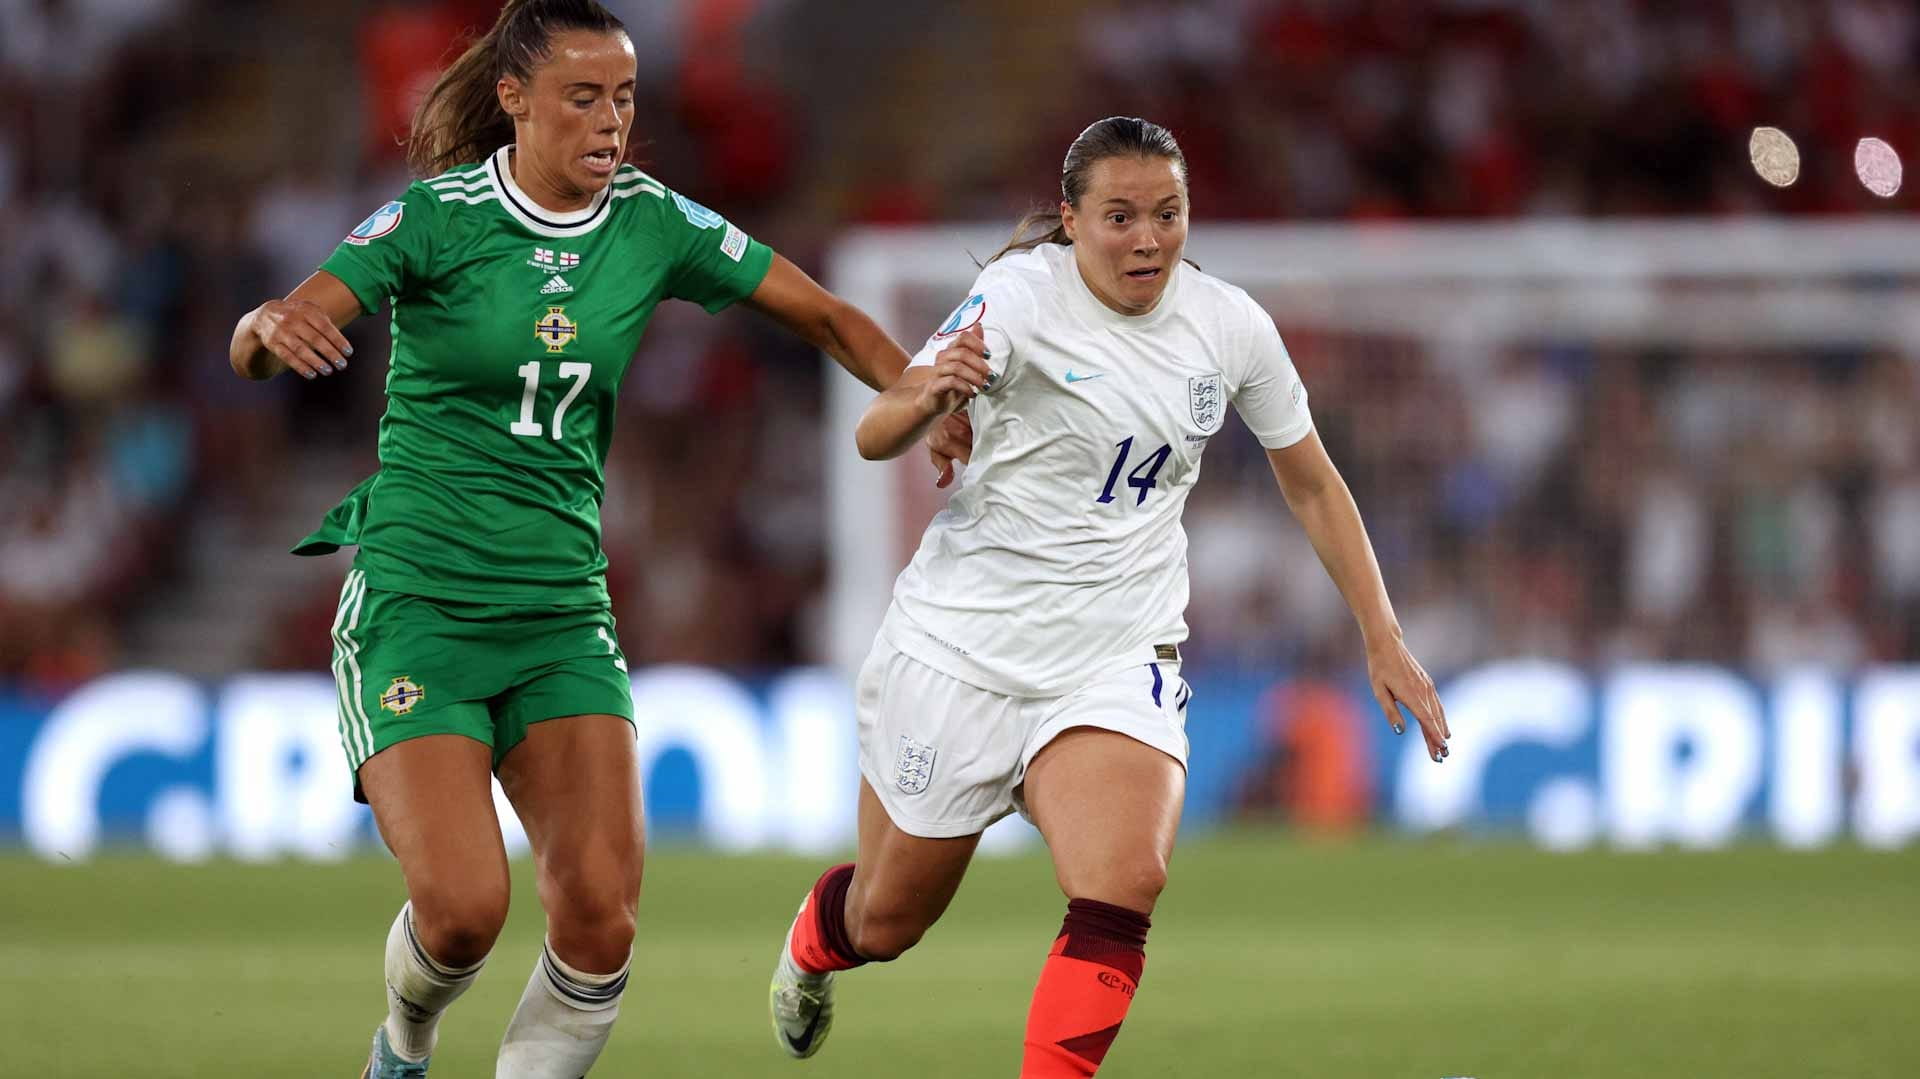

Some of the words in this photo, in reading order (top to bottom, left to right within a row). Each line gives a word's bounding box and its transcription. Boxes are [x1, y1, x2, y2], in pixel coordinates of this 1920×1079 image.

[539, 284, 575, 294] adidas
[510, 361, 592, 440] 17
[1096, 435, 1172, 507] 14
